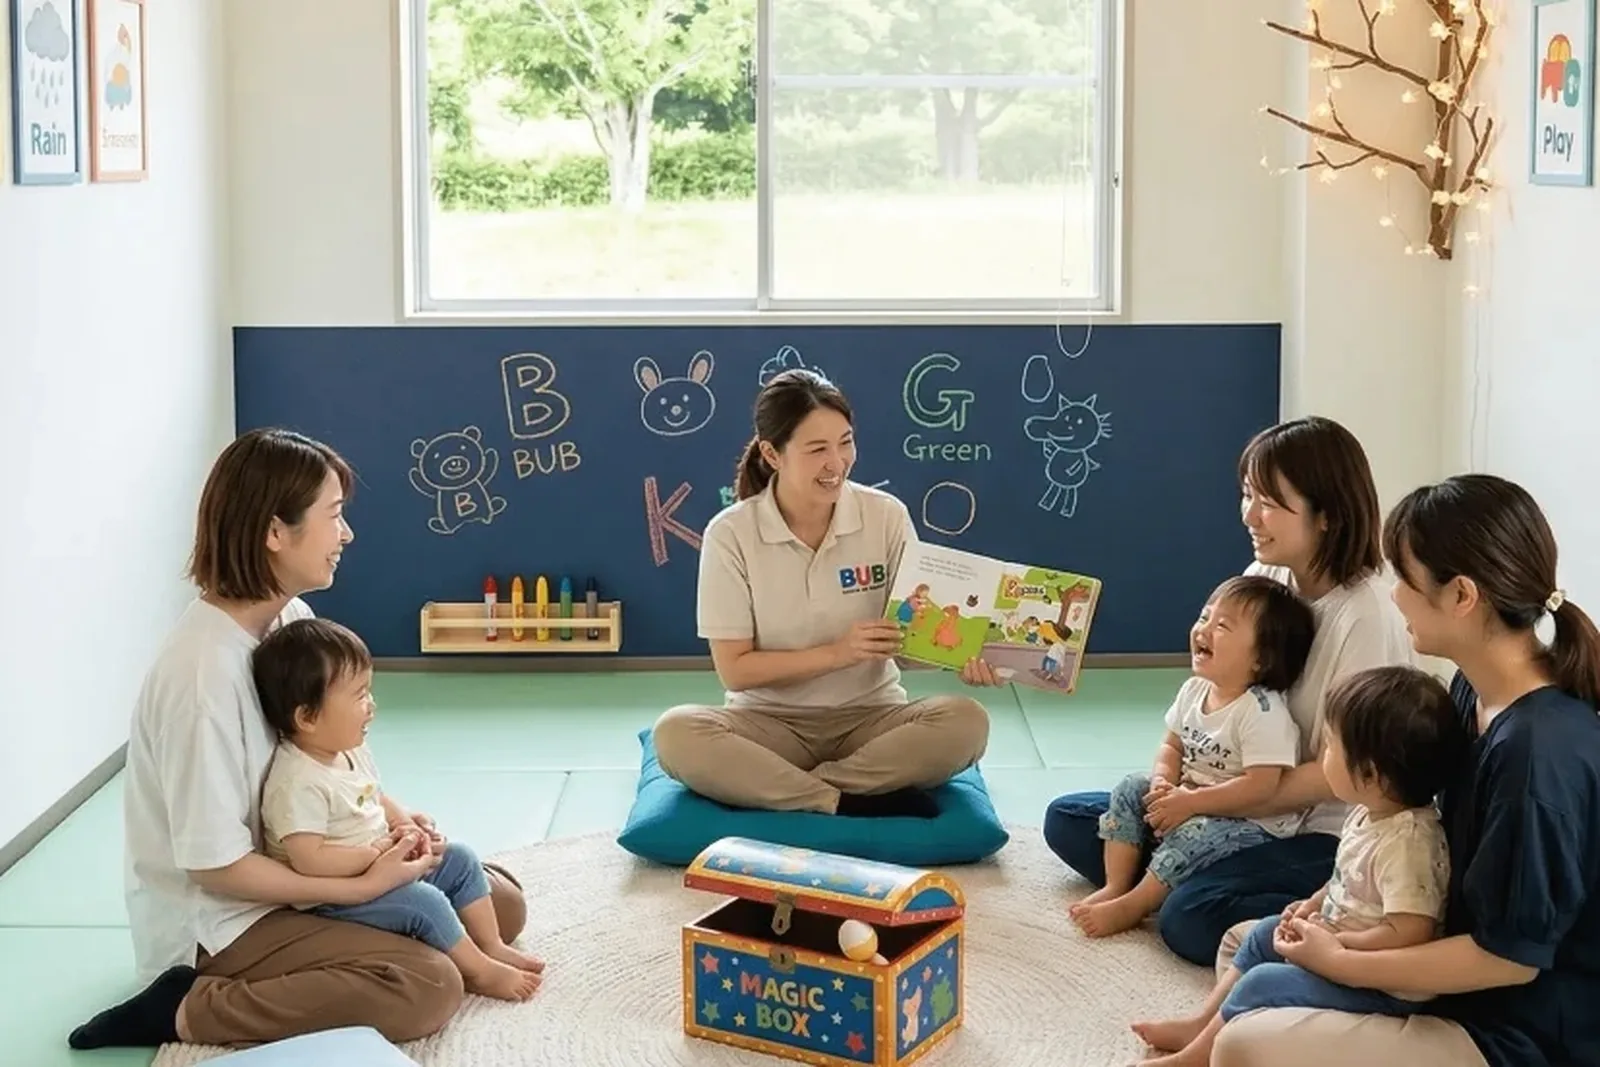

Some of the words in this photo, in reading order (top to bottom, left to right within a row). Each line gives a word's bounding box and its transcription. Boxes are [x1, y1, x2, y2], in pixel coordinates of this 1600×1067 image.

[31, 122, 67, 155] Rain
[1543, 124, 1574, 162] Play
[501, 353, 570, 439] B
[903, 353, 975, 431] G
[513, 441, 581, 479] BUB
[903, 434, 992, 461] Green
[455, 492, 477, 517] B
[644, 476, 703, 567] K
[839, 564, 885, 588] BUB
[740, 972, 826, 1012] MAGIC
[756, 1003, 811, 1038] BOX
